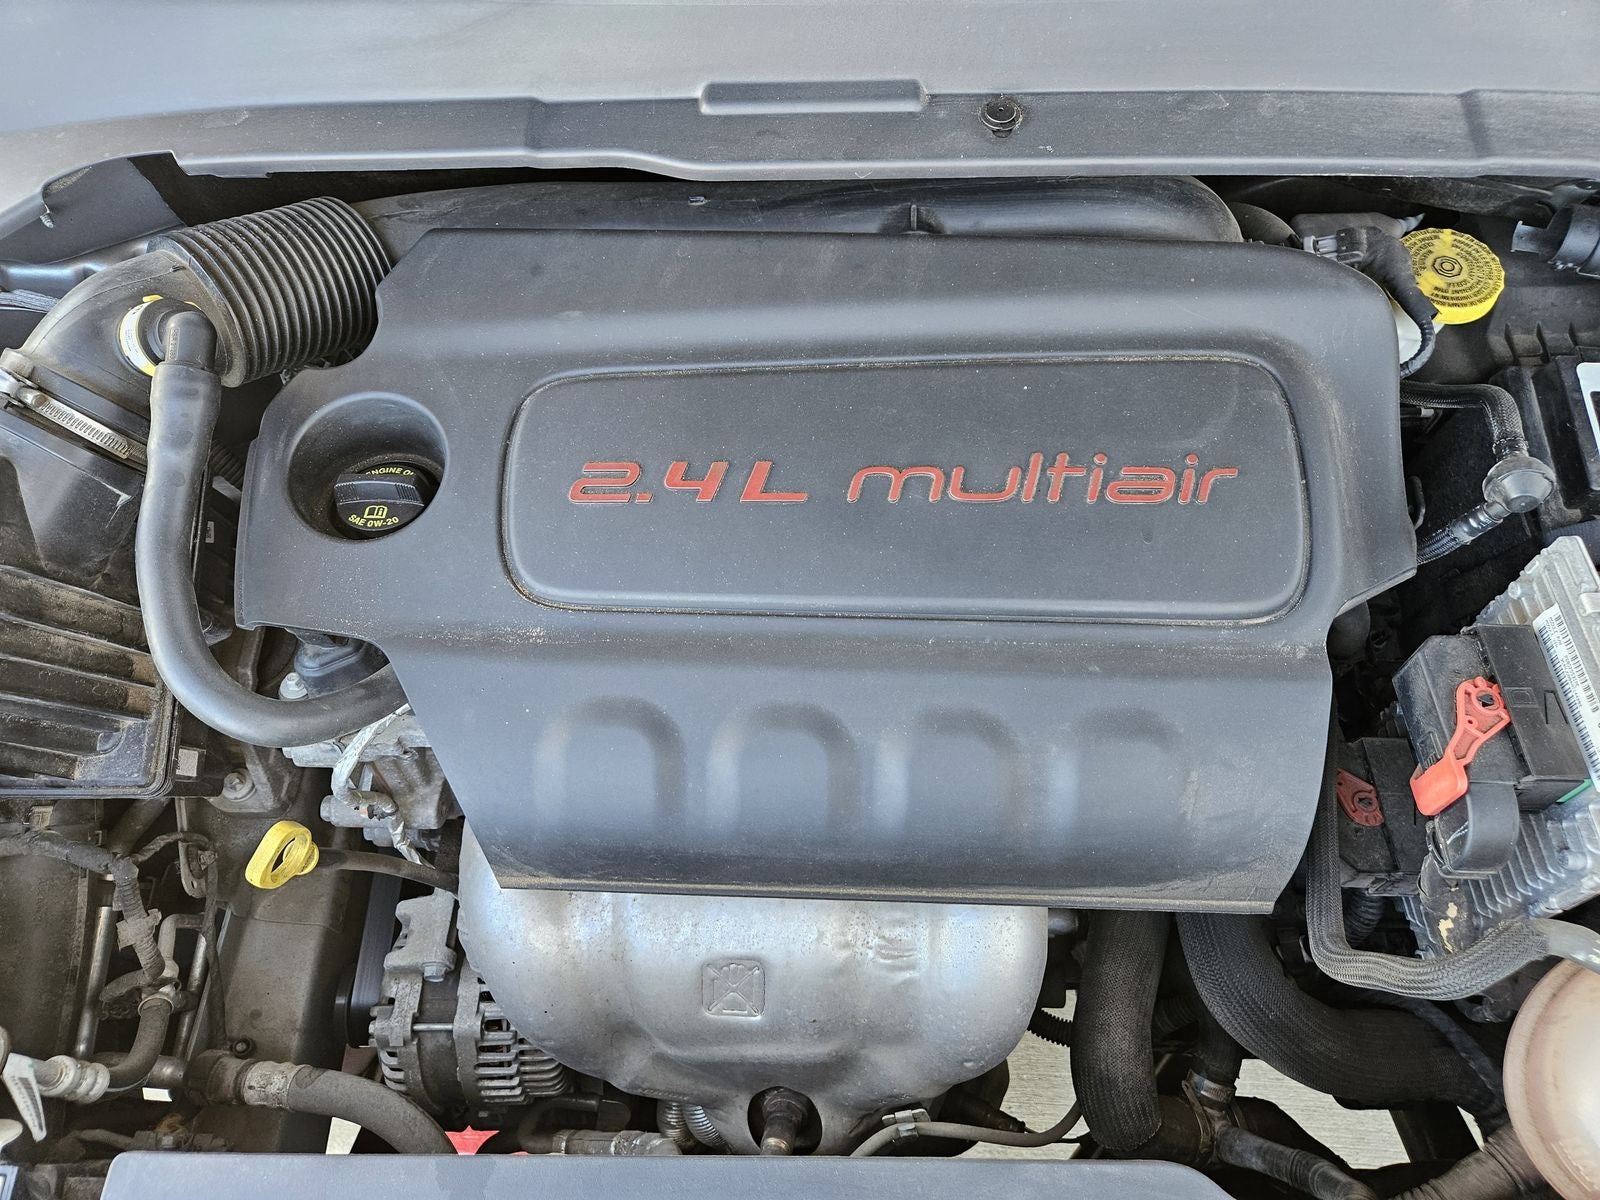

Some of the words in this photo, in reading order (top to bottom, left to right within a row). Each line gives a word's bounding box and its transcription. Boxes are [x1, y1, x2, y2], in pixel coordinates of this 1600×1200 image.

[846, 452, 1239, 505] multiair
[348, 514, 367, 526] SAE
[367, 516, 399, 527] 0W-20
